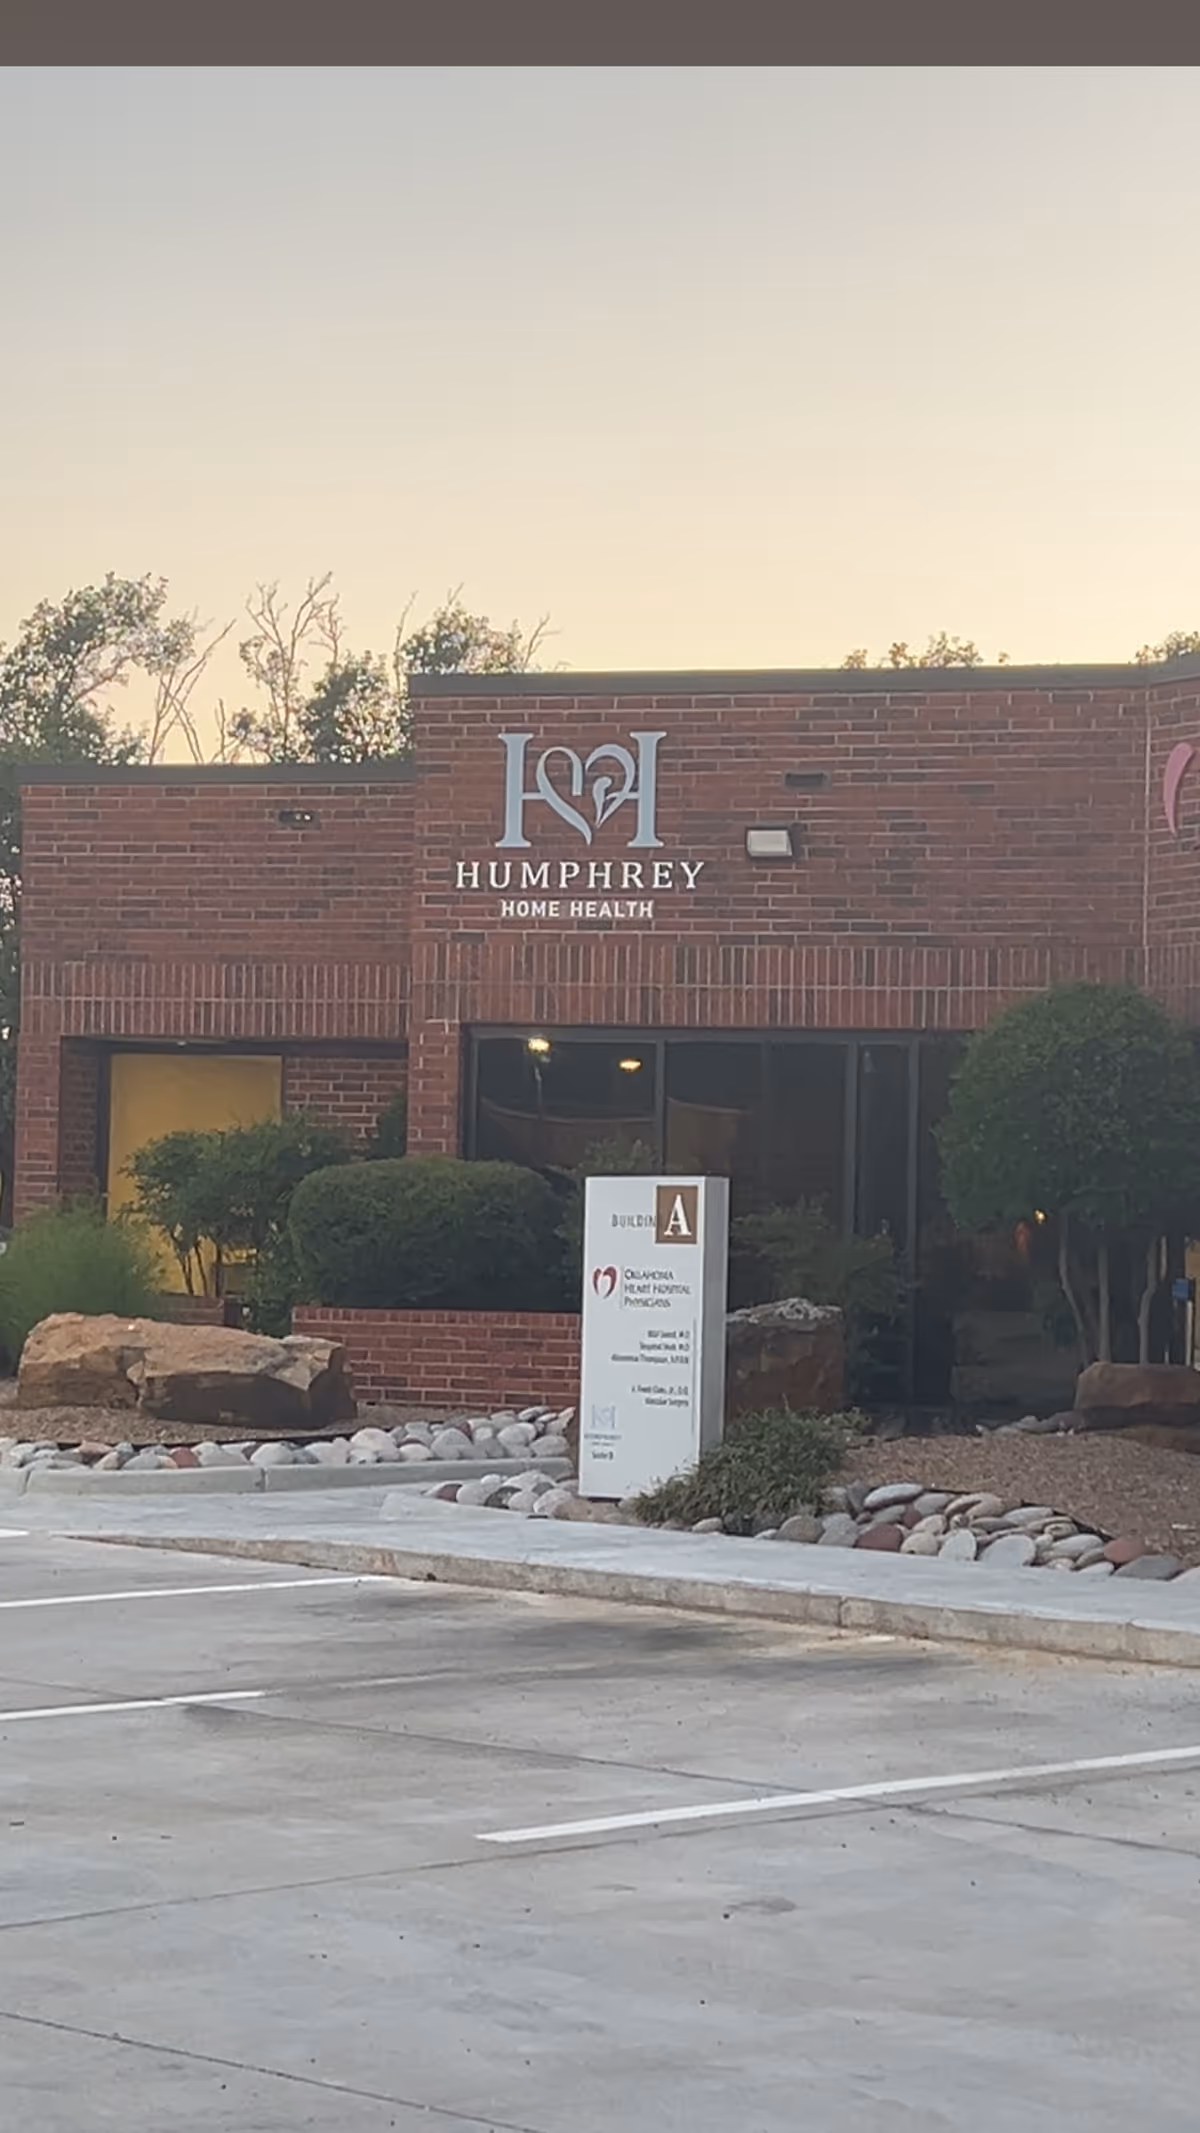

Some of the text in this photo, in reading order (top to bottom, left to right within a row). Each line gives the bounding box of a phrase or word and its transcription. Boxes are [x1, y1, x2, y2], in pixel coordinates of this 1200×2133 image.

[455, 861, 705, 889] HUMPHREY
[501, 899, 654, 918] HOME HEALTH
[612, 1194, 692, 1236] BUILDIN A
